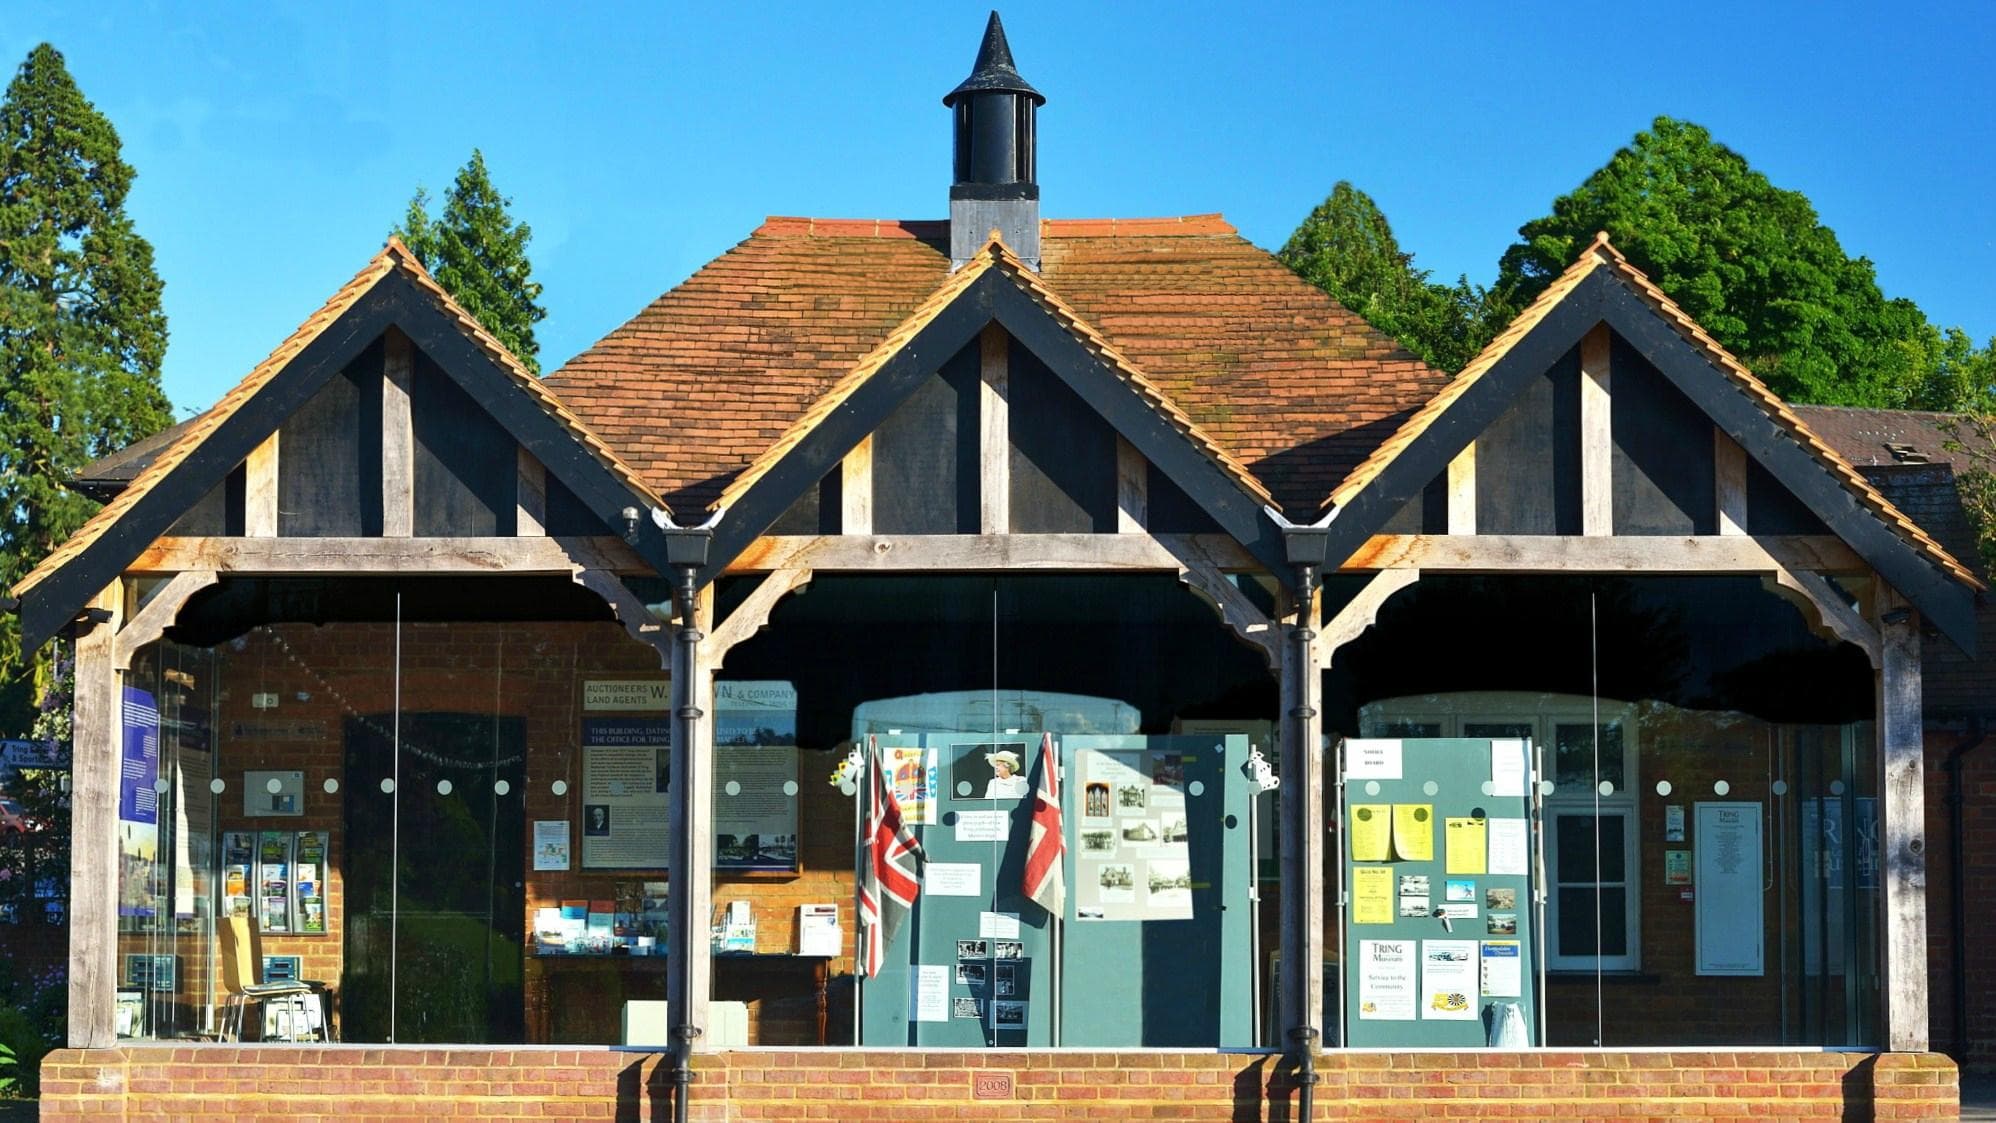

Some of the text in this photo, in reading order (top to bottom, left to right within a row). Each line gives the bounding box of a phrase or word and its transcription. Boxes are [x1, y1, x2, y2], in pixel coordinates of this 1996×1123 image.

[587, 685, 648, 693] AUCTIONEERS
[650, 686, 668, 699] W.
[748, 690, 794, 699] COMPANY
[587, 696, 647, 704] LAND AGENTS
[1372, 943, 1403, 954] TRING
[1373, 954, 1404, 962] Museum
[979, 1080, 1008, 1091] 2008
